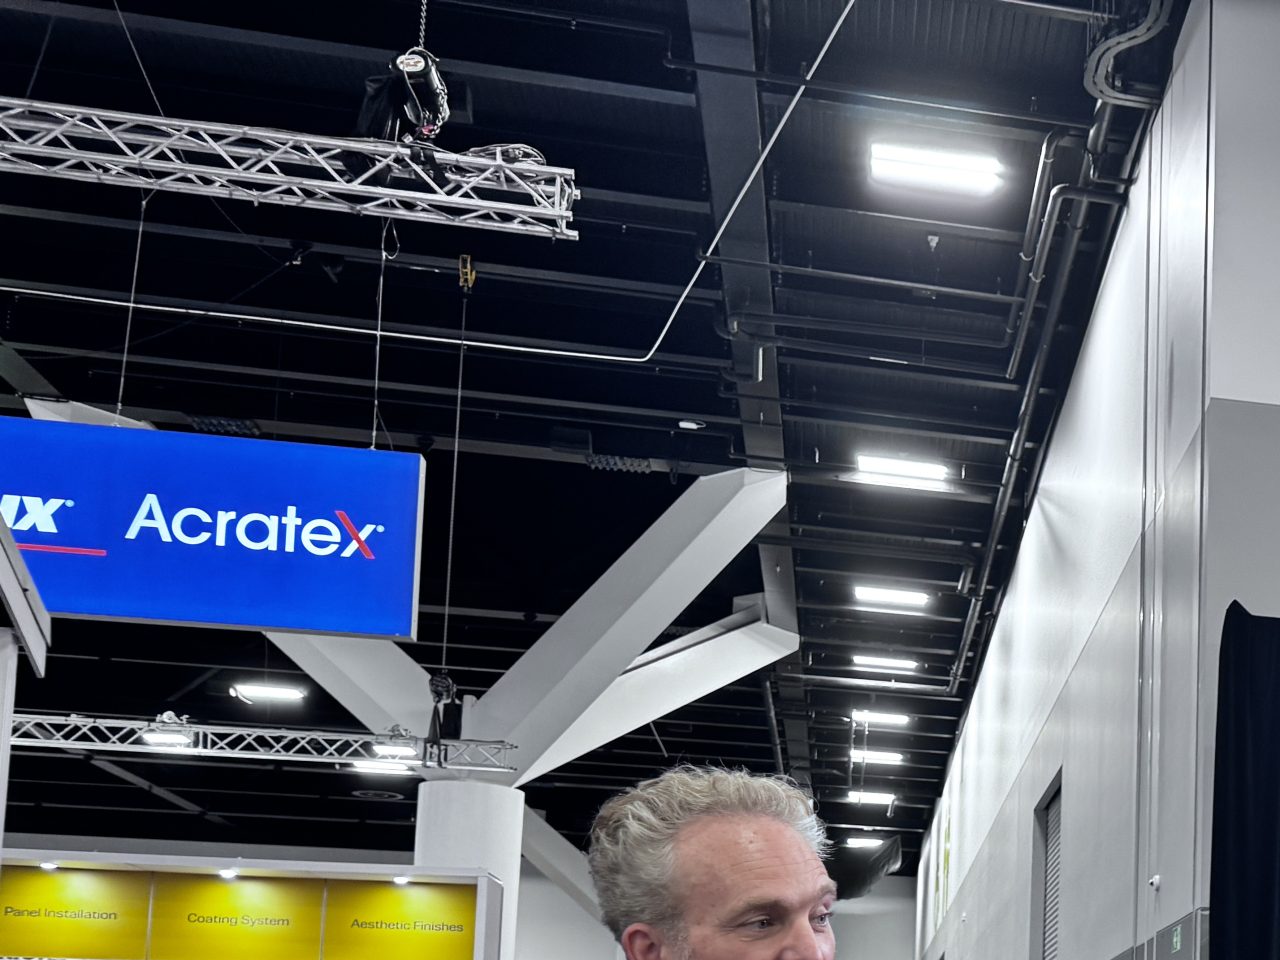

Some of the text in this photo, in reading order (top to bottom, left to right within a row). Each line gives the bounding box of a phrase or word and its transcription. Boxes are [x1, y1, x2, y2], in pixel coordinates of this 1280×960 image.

[4, 906, 117, 920] Panel Installation
[187, 912, 290, 927] Coating System
[350, 918, 464, 932] Aesthetic Finishes
